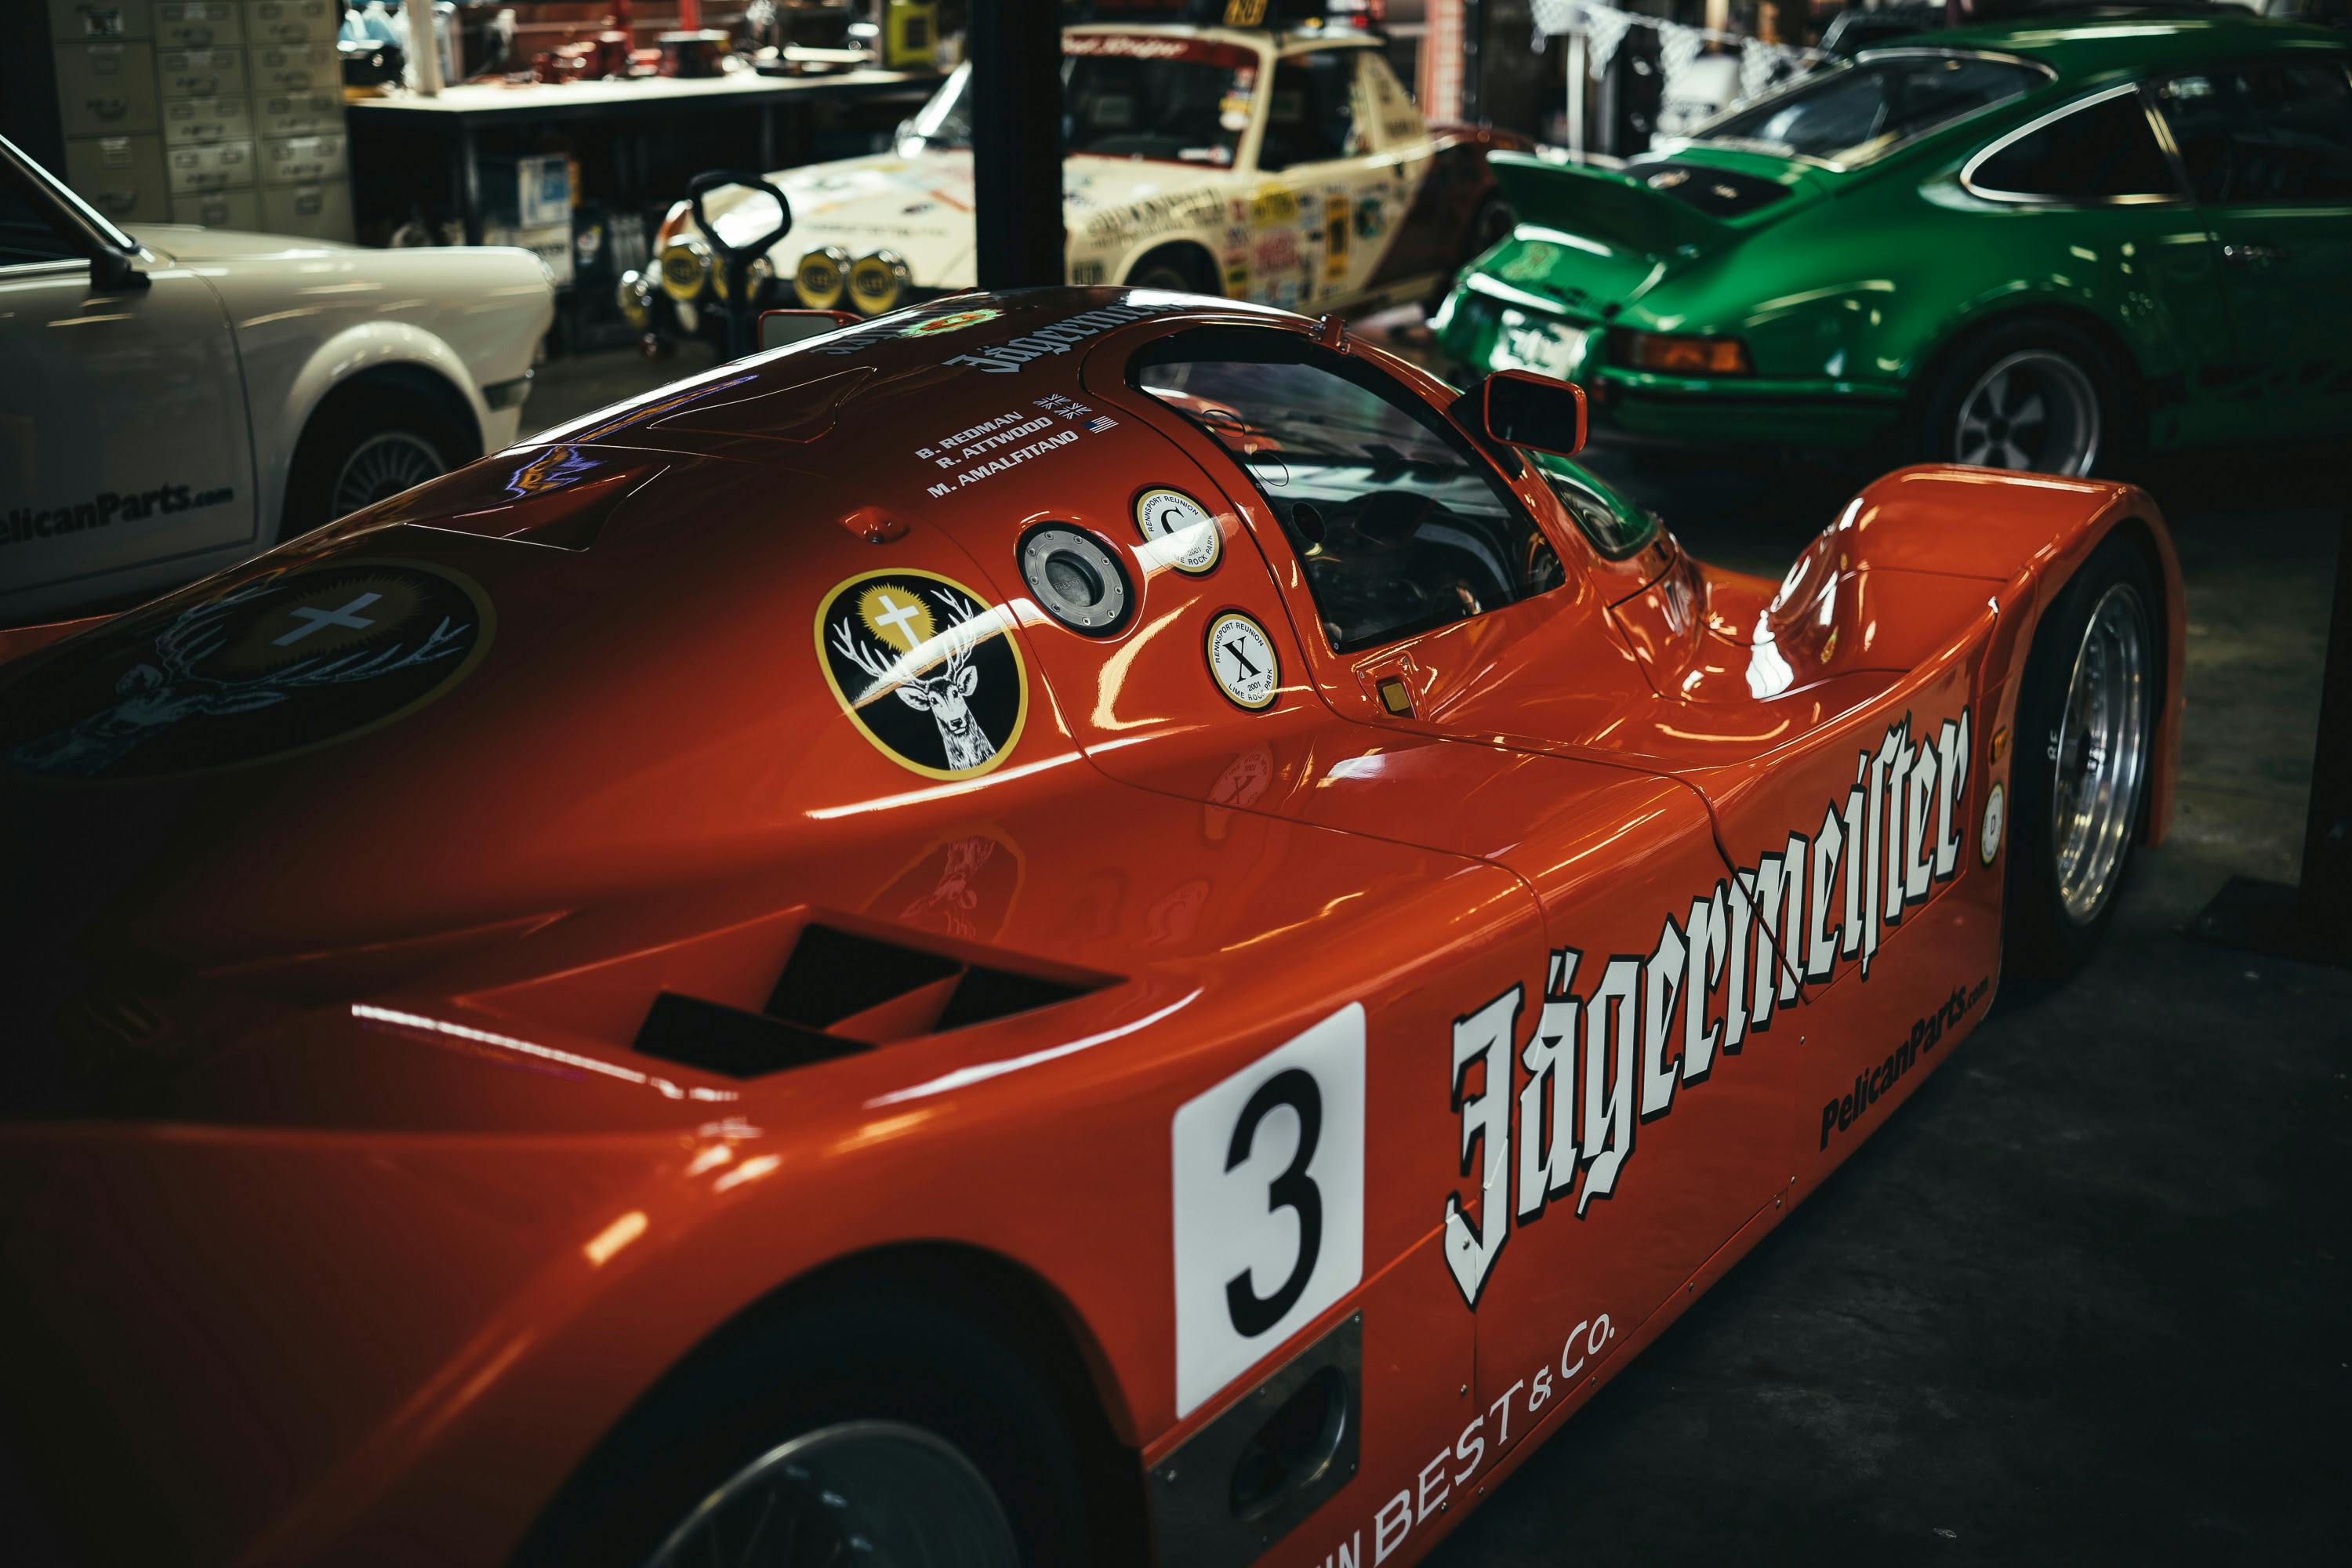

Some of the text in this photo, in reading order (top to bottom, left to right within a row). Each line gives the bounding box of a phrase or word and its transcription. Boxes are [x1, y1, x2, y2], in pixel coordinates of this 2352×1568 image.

[915, 411, 1024, 459] B. REDMAN
[935, 416, 1054, 469] R. ATTWOOD
[927, 430, 1079, 498] M. AMALFITANO
[1145, 495, 1199, 532] RENNSPORT REUNION
[1188, 555, 1208, 565] ROCK
[1214, 622, 1264, 663] RENNSPORT REUNION
[1222, 635, 1261, 683] X
[1229, 683, 1245, 699] LIME
[1247, 681, 1261, 691] 2001
[1225, 1069, 1322, 1337] 3
[1374, 1378, 1524, 1568] BEST
[1528, 1364, 1553, 1412] &
